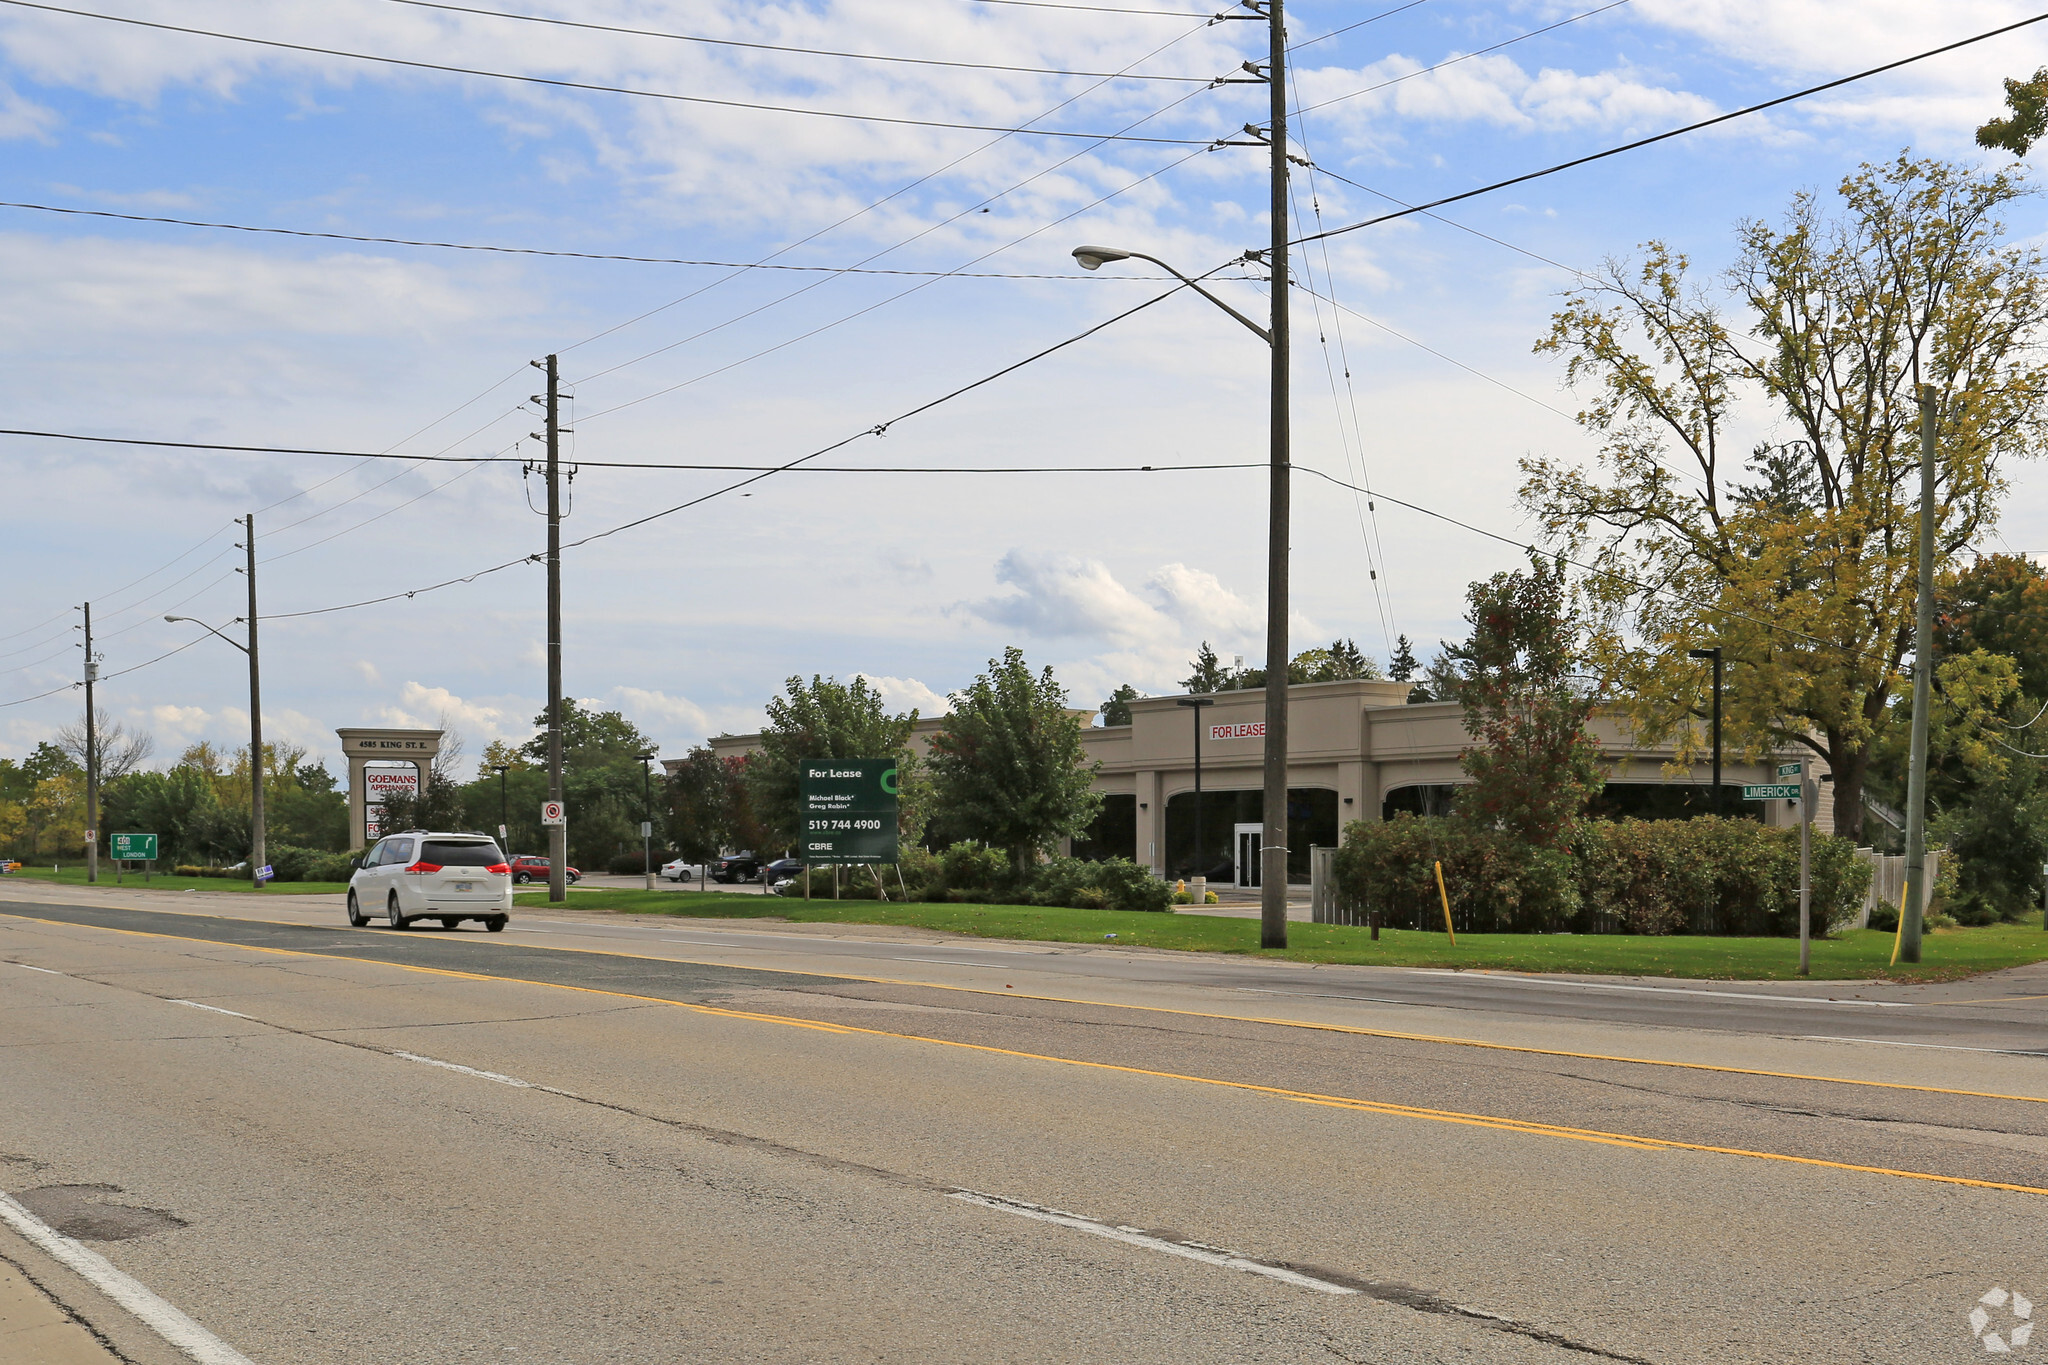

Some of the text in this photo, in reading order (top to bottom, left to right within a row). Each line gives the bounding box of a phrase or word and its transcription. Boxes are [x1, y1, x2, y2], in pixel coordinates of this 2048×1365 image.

[1212, 724, 1266, 738] FOR LEASE
[809, 769, 862, 778] For Lease
[1782, 766, 1794, 774] KING
[368, 775, 416, 783] GOEMANS
[1744, 787, 1790, 797] LIMERICK
[808, 820, 881, 830] 519 744 4900
[808, 842, 833, 851] CBRE
